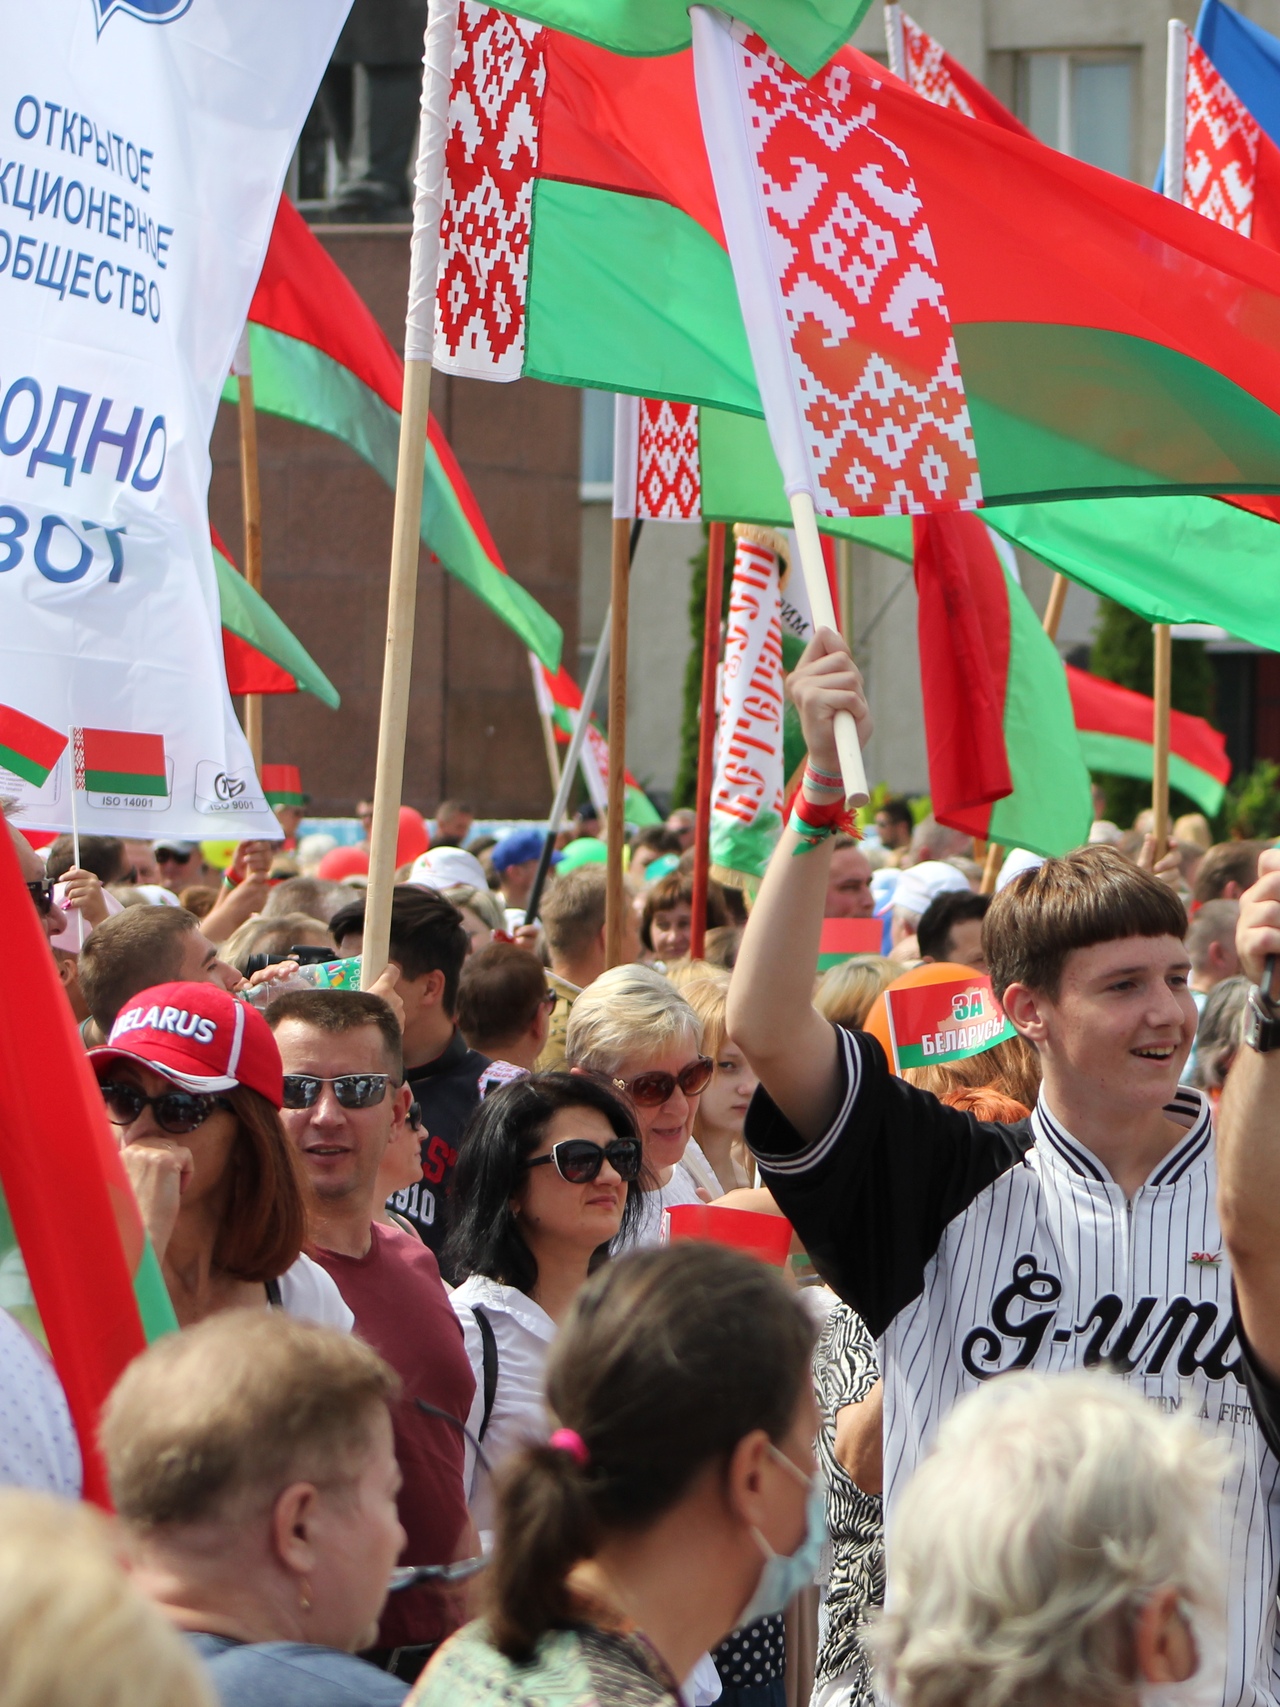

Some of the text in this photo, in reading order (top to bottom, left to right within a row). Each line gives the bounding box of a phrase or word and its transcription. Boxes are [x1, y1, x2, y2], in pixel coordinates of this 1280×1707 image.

[14, 95, 154, 193] ОТКРЫТОЕ
[102, 796, 153, 808] ISO 14001
[232, 800, 254, 810] 9001
[951, 991, 985, 1022] ЗА
[111, 1005, 217, 1044] BELARUS
[921, 1014, 1006, 1056] БЕЛАРУСЬ!
[1219, 1402, 1254, 1426] FIFTY
